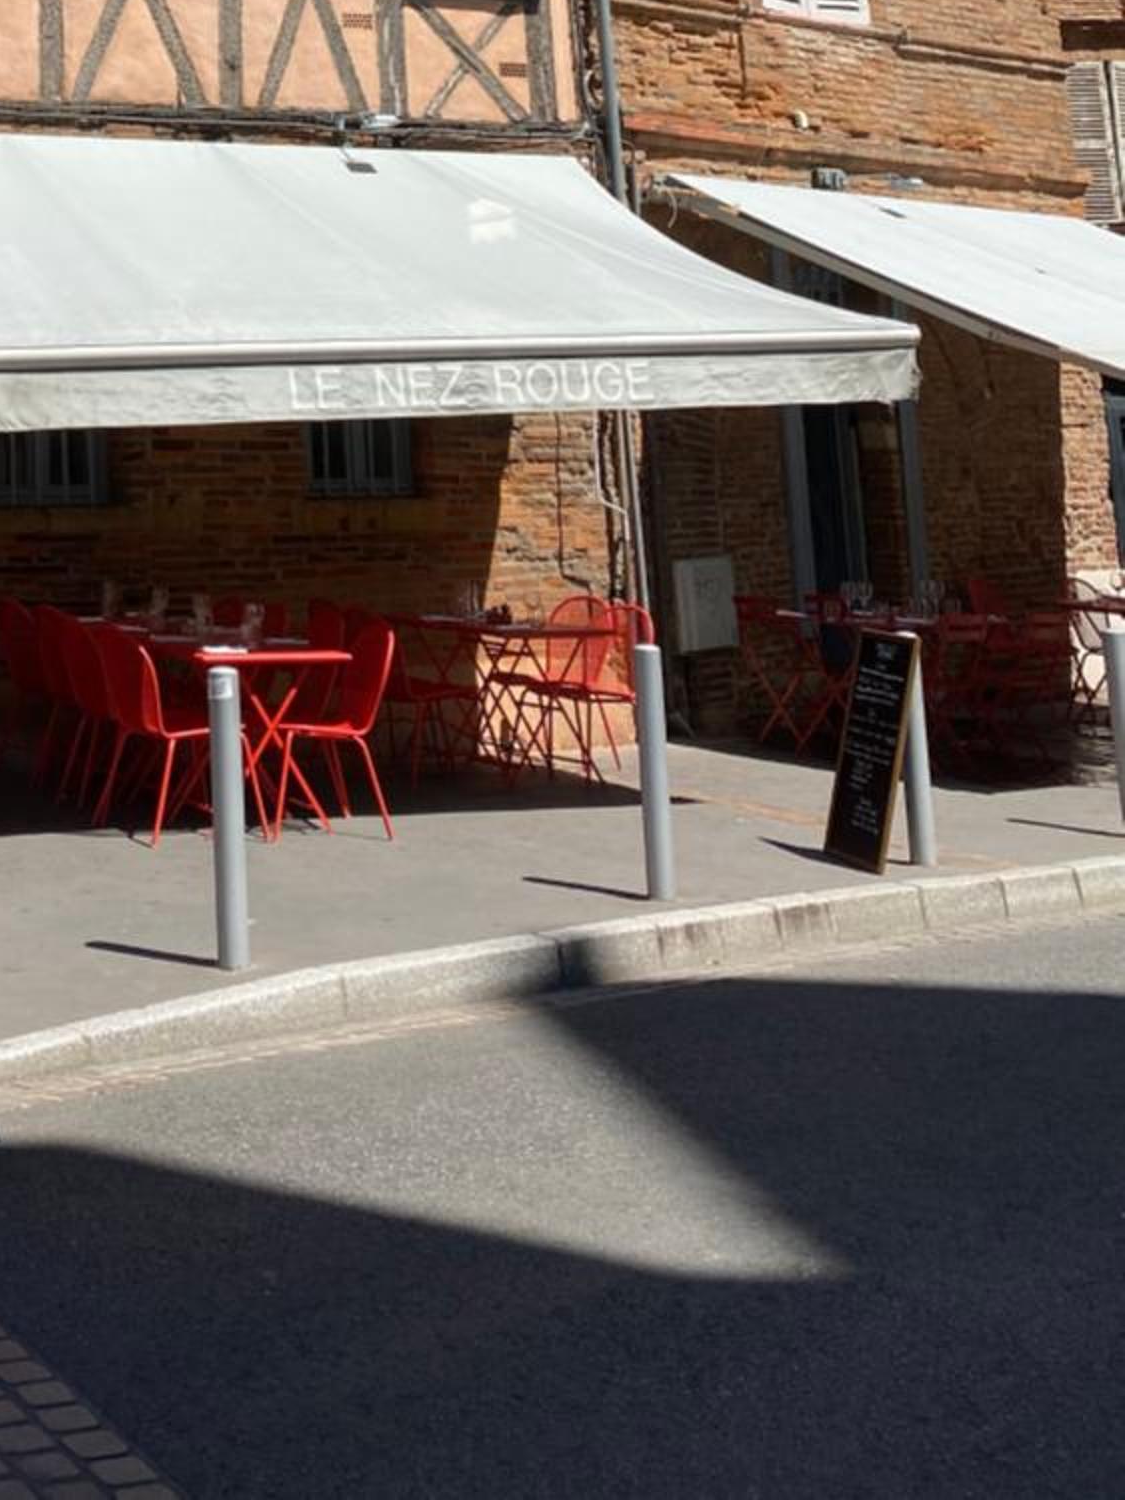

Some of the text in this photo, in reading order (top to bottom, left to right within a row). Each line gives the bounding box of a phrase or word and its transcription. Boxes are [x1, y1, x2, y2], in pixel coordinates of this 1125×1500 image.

[287, 360, 655, 410] LE NEZ ROUGE
